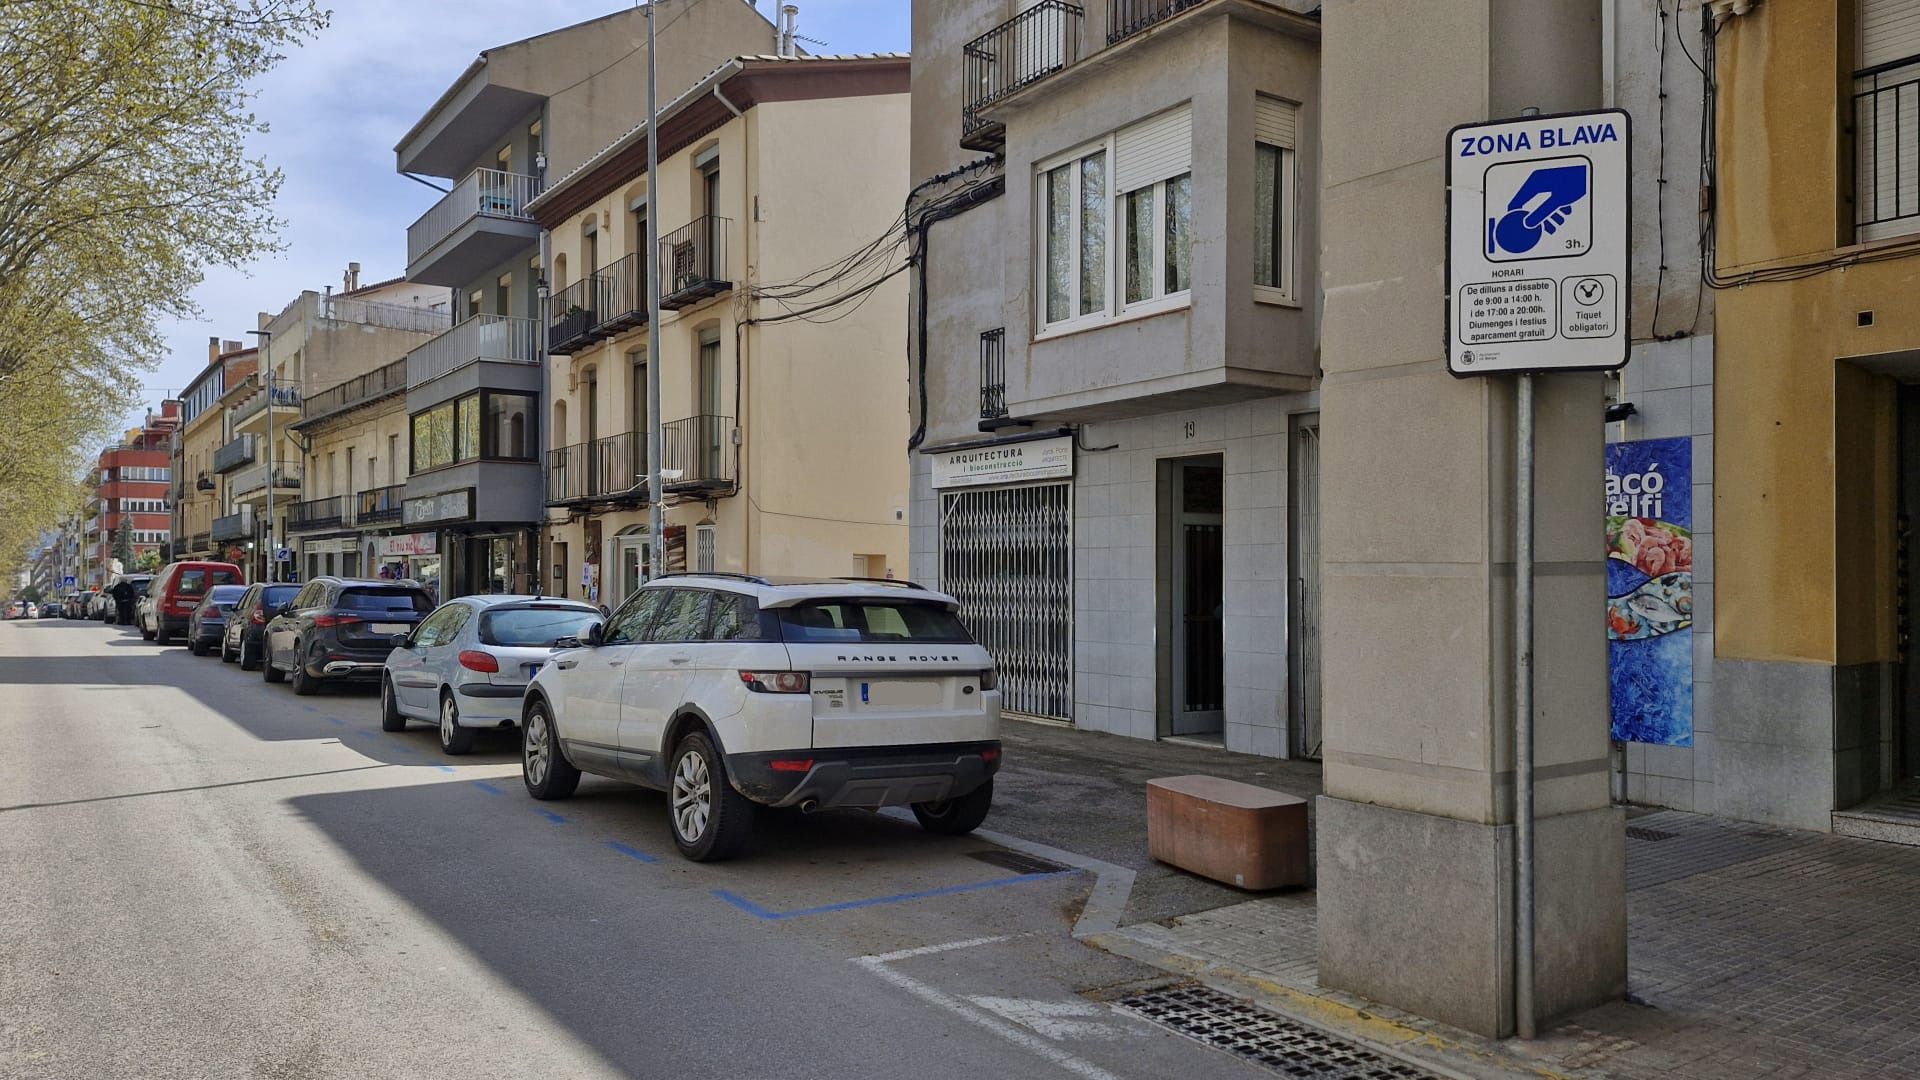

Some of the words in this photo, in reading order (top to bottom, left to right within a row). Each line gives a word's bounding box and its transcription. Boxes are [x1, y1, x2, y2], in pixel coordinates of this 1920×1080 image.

[1460, 132, 1531, 157] ZONA
[1540, 123, 1618, 149] BLAVA
[1565, 239, 1585, 249] 3h.
[1491, 268, 1524, 278] HORARI
[1467, 287, 1478, 295] De
[1480, 285, 1506, 294] dilluns
[1515, 282, 1549, 292] dissabte
[1473, 298, 1484, 306] de
[1485, 297, 1502, 305] 9:00
[1511, 294, 1533, 303] 14:00
[1534, 294, 1542, 302] h.
[1475, 310, 1485, 318] de
[1487, 308, 1508, 317] 17:00
[1516, 306, 1546, 315] 20:00h.
[1576, 311, 1602, 320] Tiquet
[1469, 320, 1513, 330] Diumenges
[1519, 318, 1547, 326] festius
[1569, 322, 1609, 333] obligatori
[1470, 330, 1517, 342] aparcament
[1183, 421, 1195, 439] 19
[949, 447, 1023, 465] ARQUITECTURA
[969, 460, 1023, 472] bioconstrucció
[1606, 463, 1664, 495] acó
[1606, 493, 1662, 518] elfi
